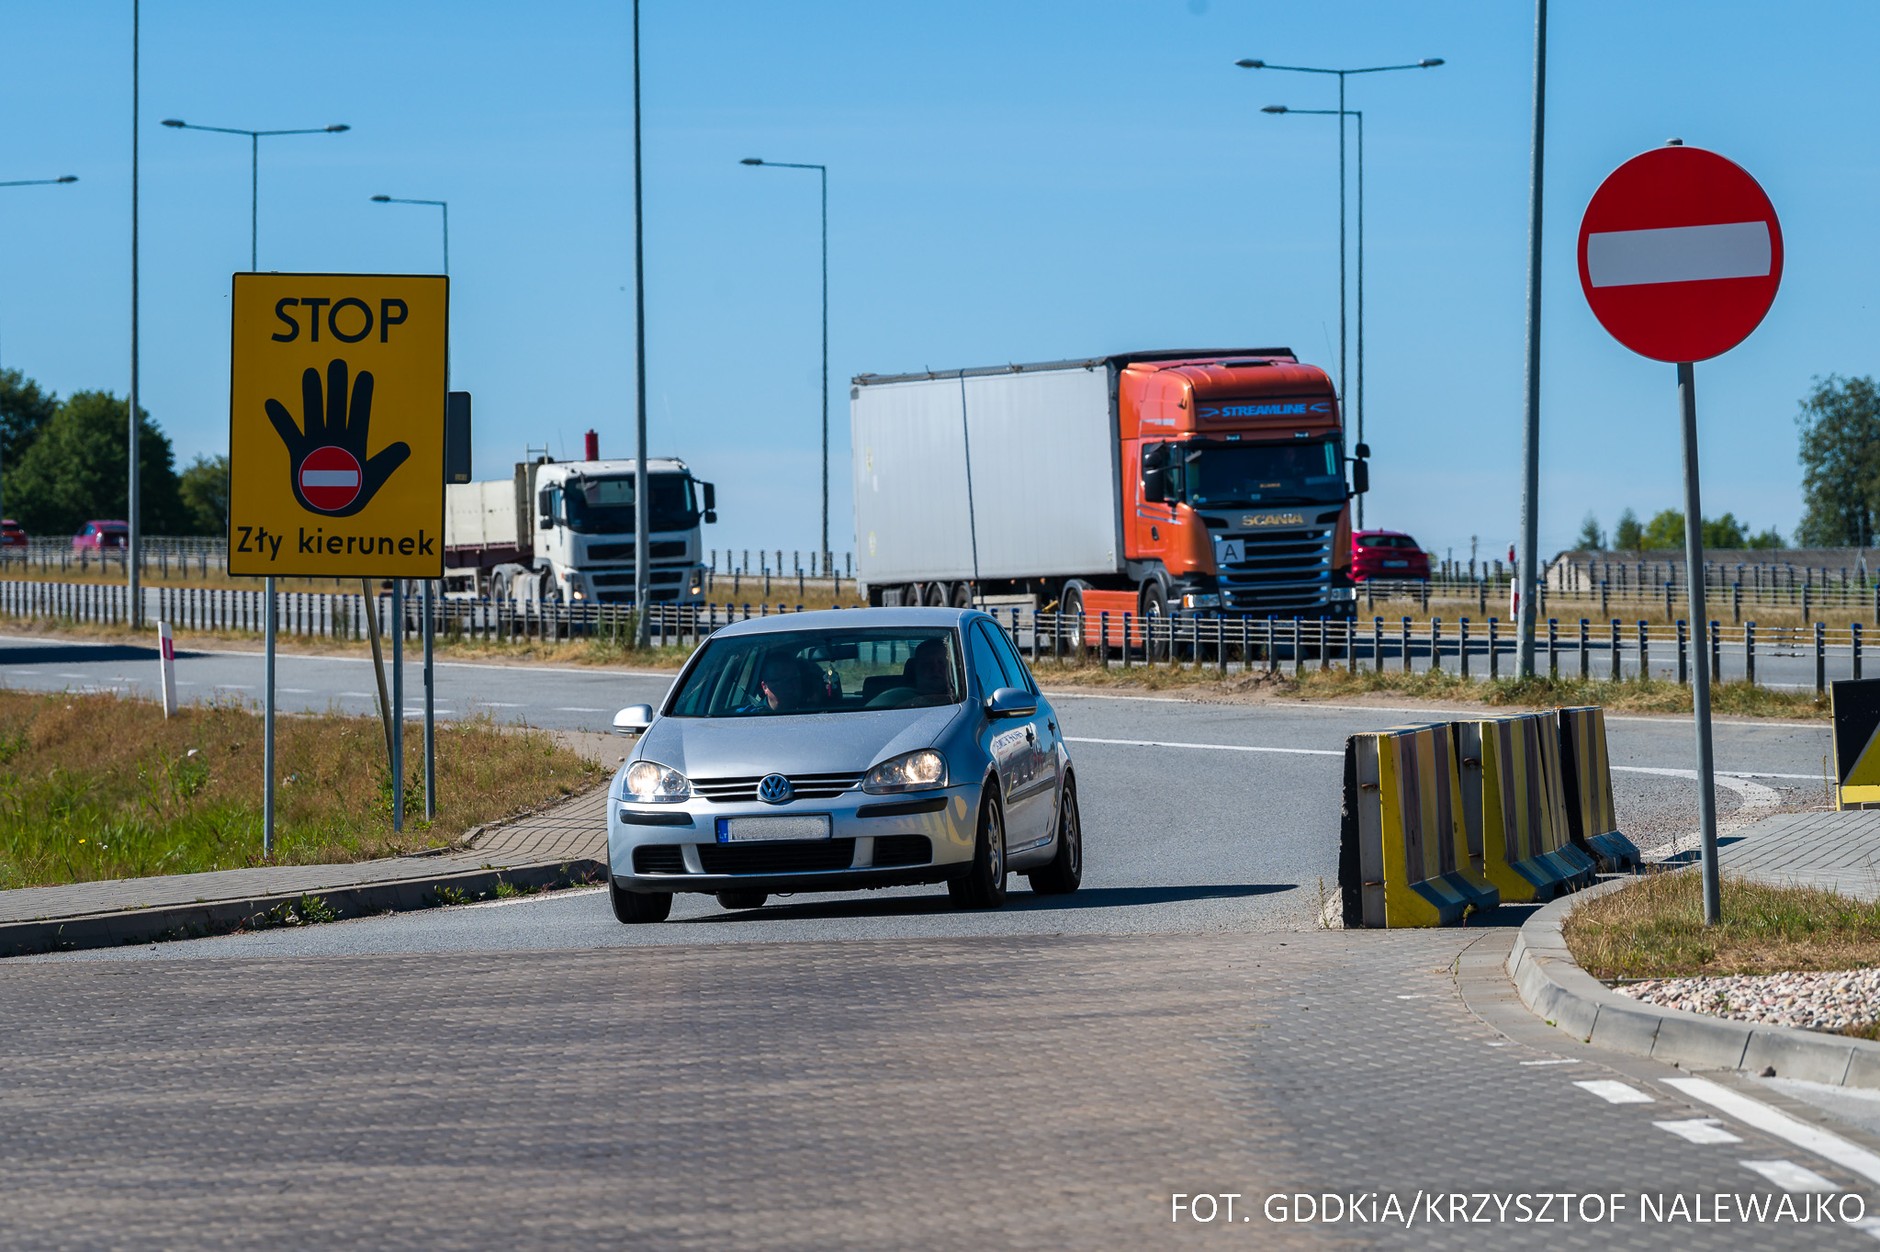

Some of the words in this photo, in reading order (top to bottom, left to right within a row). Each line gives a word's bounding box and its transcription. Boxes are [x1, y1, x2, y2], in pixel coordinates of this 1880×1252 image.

[271, 297, 409, 344] STOP
[1221, 403, 1307, 417] STREAMLINE
[1241, 513, 1304, 526] SCANIA
[237, 526, 283, 562] Zły
[298, 527, 434, 556] kierunek
[1223, 543, 1238, 561] A
